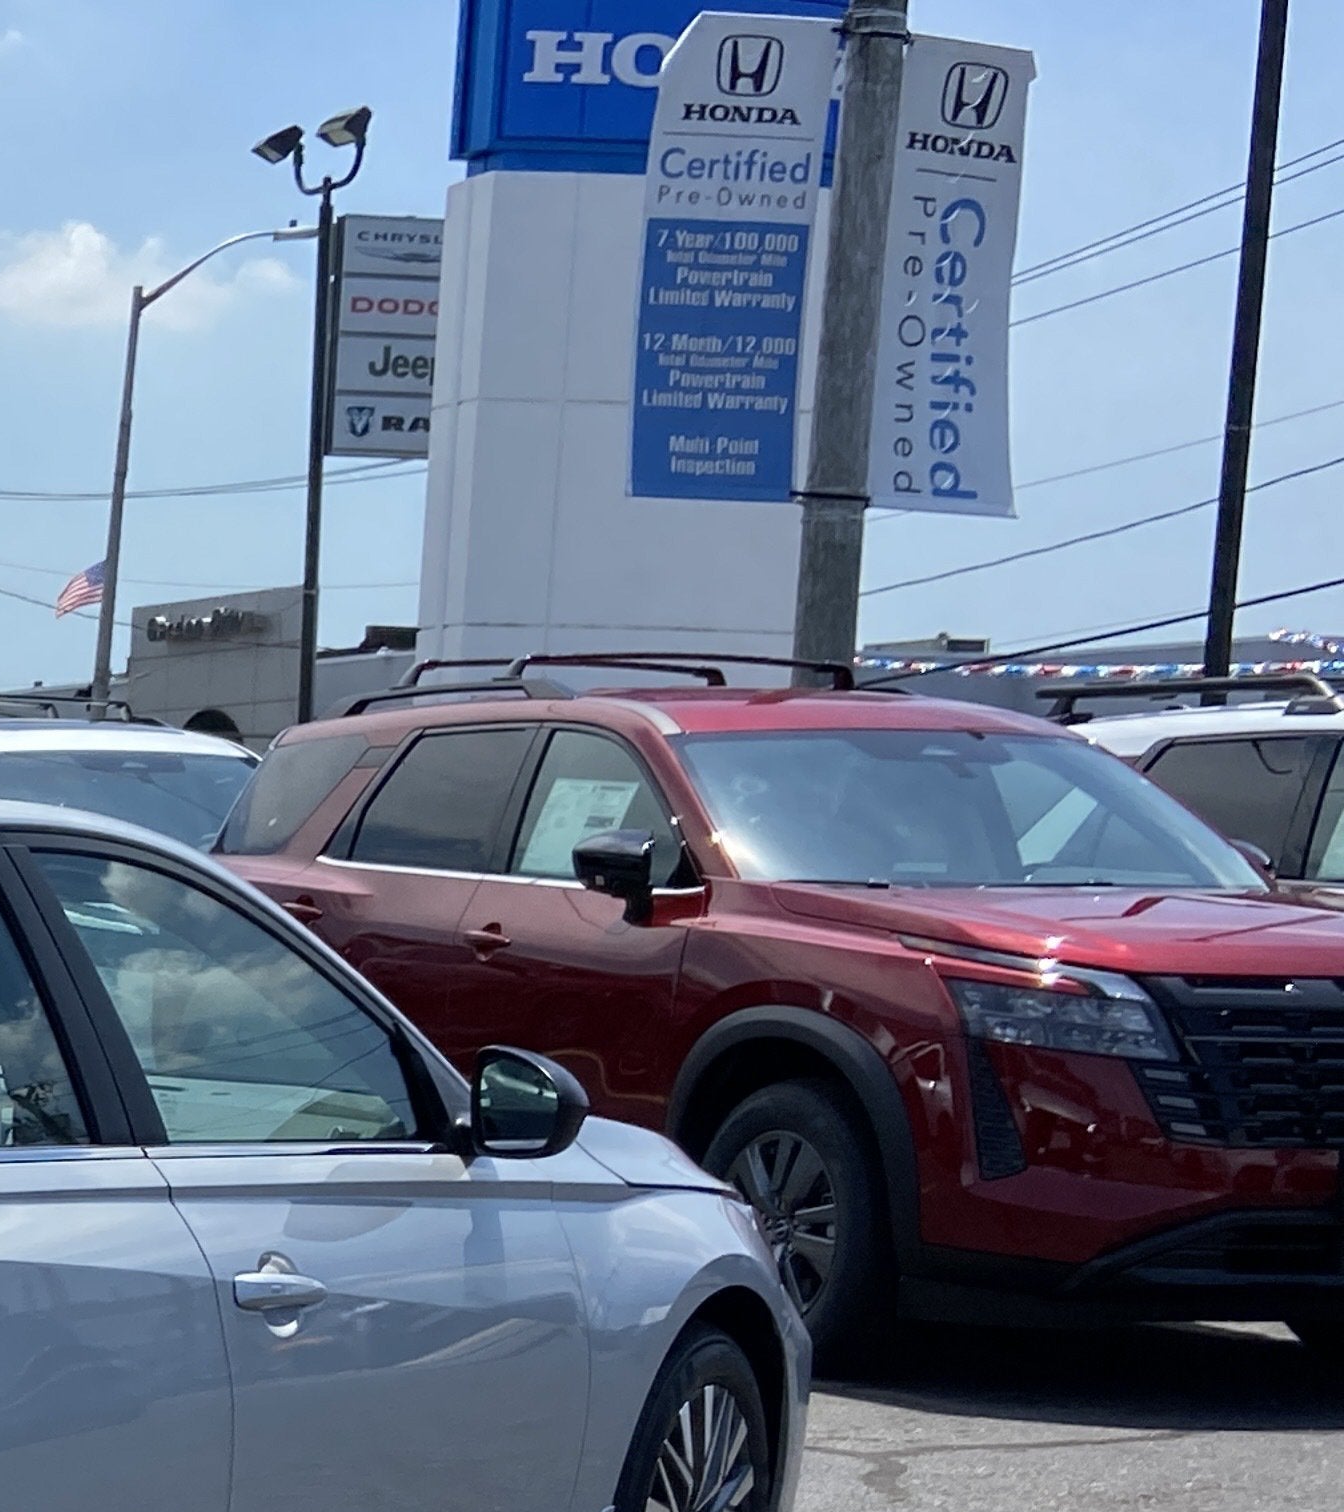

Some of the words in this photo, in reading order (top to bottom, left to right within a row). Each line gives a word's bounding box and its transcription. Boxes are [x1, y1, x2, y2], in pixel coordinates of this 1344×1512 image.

[682, 103, 801, 126] HONDA
[906, 132, 1017, 164] HONDA
[661, 147, 811, 185] Certified
[657, 185, 807, 210] Pre-Owned
[357, 230, 443, 246] CHRYSL
[676, 267, 773, 287] Powertrain
[350, 297, 439, 317] DOD
[648, 287, 710, 306] Limited
[714, 290, 797, 313] Warranty
[893, 195, 937, 495] Pre-Owned
[929, 198, 986, 500] Certified
[368, 345, 435, 386] Jee
[669, 369, 766, 389] Powertrain
[642, 389, 703, 409] Limited
[707, 392, 788, 415] Warranty
[381, 415, 430, 433] RA
[670, 456, 756, 476] Inspection
